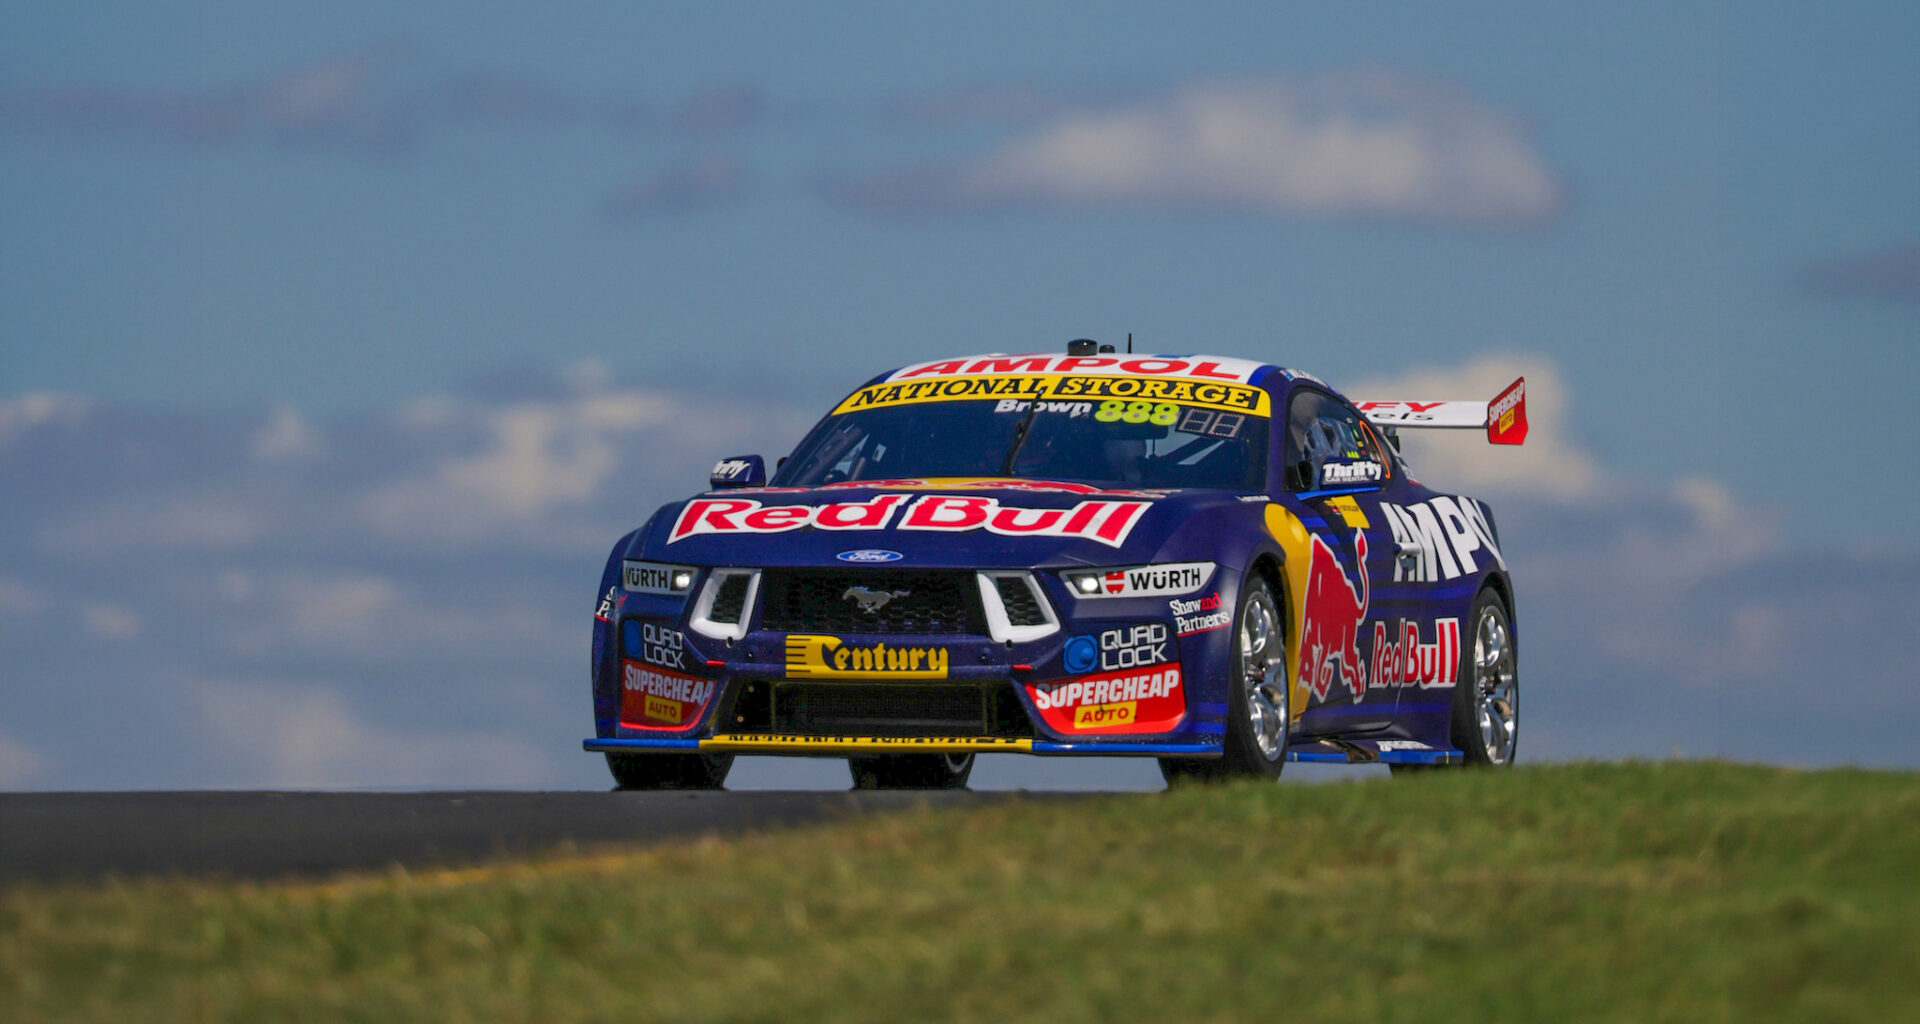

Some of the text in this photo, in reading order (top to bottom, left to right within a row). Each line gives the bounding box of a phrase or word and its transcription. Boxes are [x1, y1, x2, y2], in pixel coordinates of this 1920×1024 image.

[898, 357, 1240, 380] AMPOL
[850, 376, 1048, 408] NATIONAL
[1060, 376, 1253, 408] STORAGE
[994, 399, 1181, 426] Brown 888
[1350, 401, 1446, 413] FY
[1322, 460, 1382, 481] Thrifty
[667, 494, 1154, 548] Red Bull
[1130, 568, 1202, 591] WÜRTH
[1175, 611, 1231, 634] Partners
[643, 623, 684, 650] QUAD
[1101, 624, 1167, 651] QUAD
[643, 645, 686, 670] LOCK
[821, 642, 948, 672] Century
[1102, 642, 1168, 670] LOCK
[1369, 617, 1461, 690] Red Bull
[624, 664, 714, 707] SUPERCHEAP
[1035, 669, 1180, 710] SUPERCHEAP
[649, 703, 678, 718] AUTO
[1080, 707, 1130, 724] AUTO
